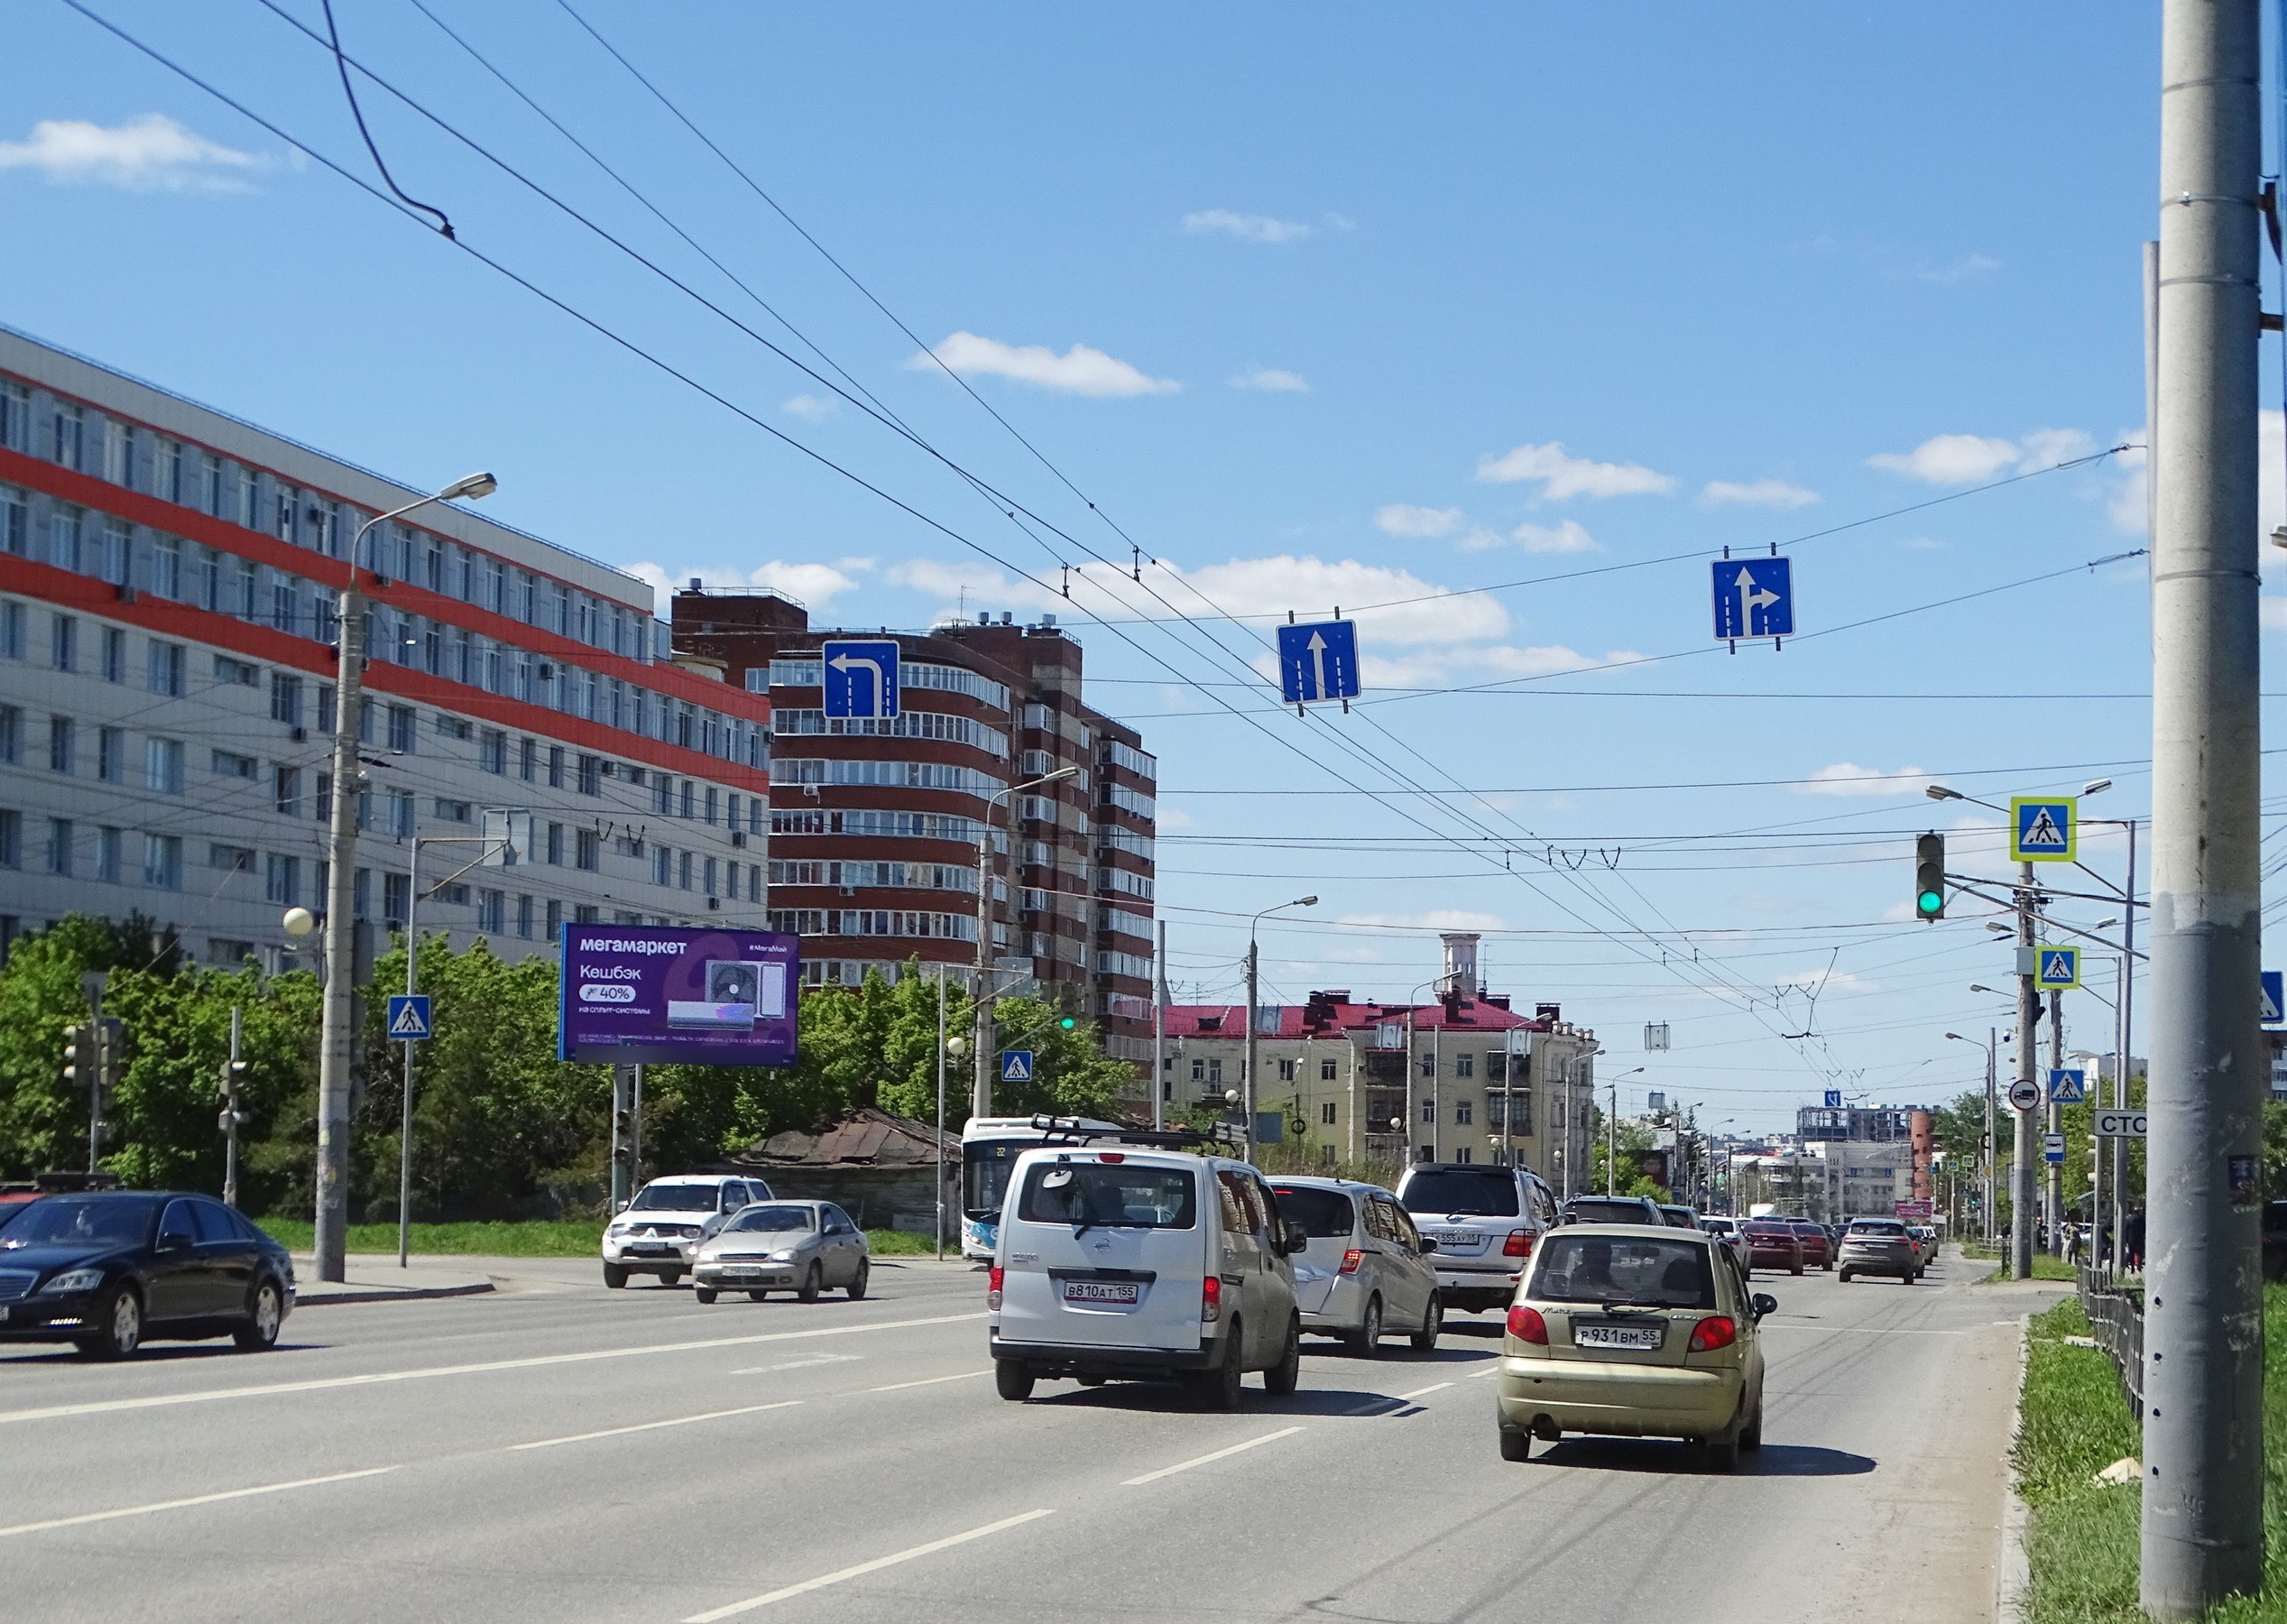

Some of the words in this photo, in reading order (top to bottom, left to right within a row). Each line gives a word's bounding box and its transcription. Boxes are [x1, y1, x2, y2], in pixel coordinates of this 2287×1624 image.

[579, 938, 687, 955] мегамаркет
[579, 964, 642, 981] Кешбэк
[600, 987, 631, 1000] 40%
[1116, 1287, 1134, 1296] 155
[1642, 1330, 1656, 1341] 55
